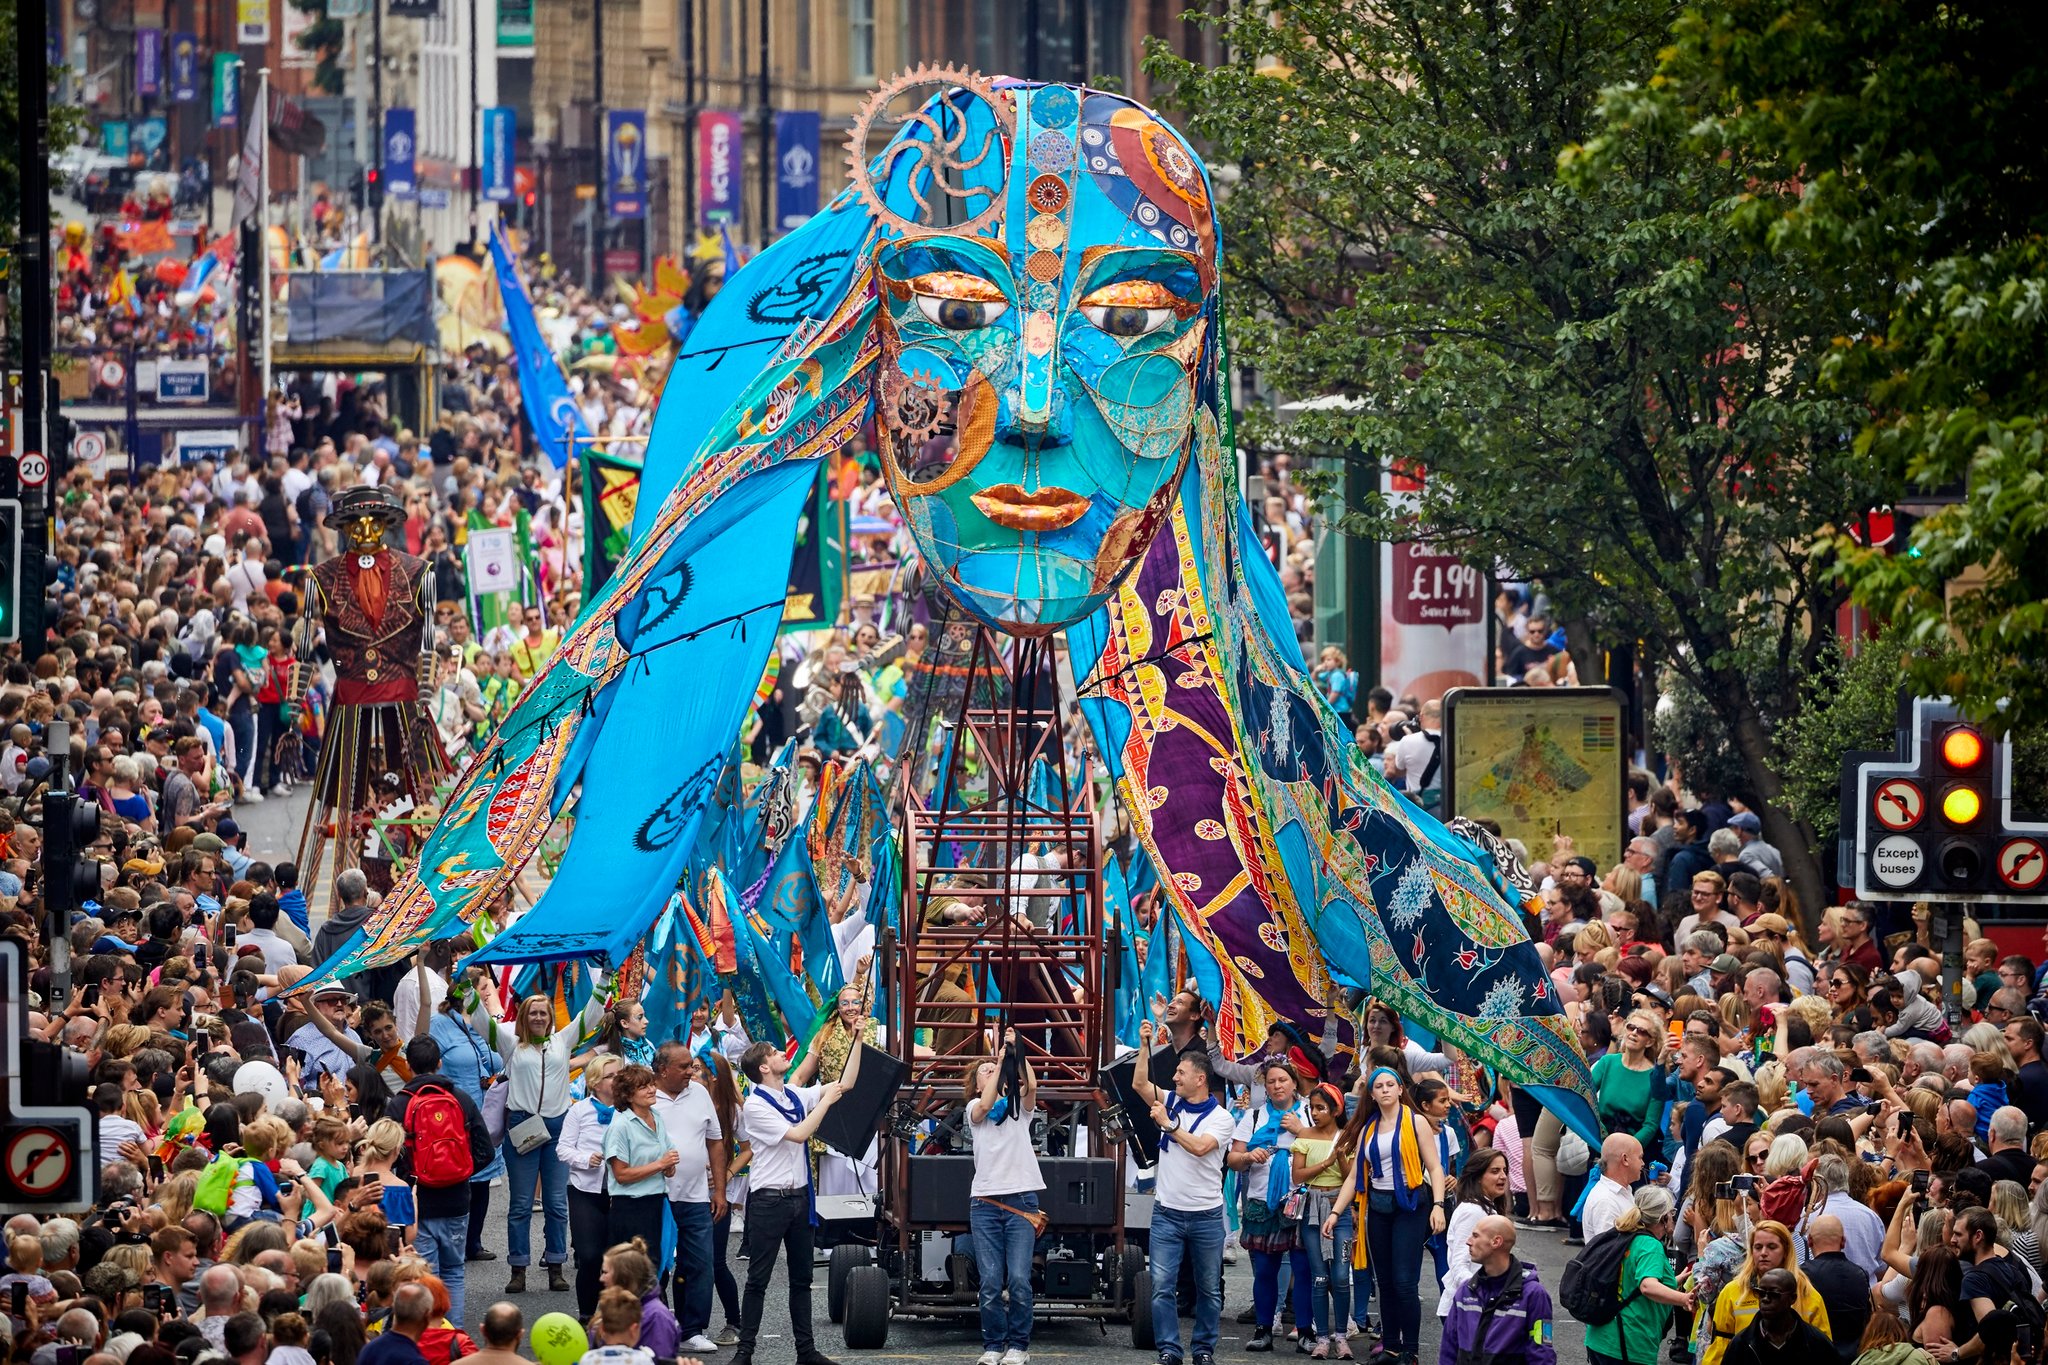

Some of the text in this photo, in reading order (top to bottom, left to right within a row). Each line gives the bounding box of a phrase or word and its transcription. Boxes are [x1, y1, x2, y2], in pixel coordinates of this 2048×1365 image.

[22, 461, 46, 475] 20
[1407, 564, 1477, 600] £1.99
[1877, 847, 1919, 861] Except
[1880, 863, 1916, 874] buses
